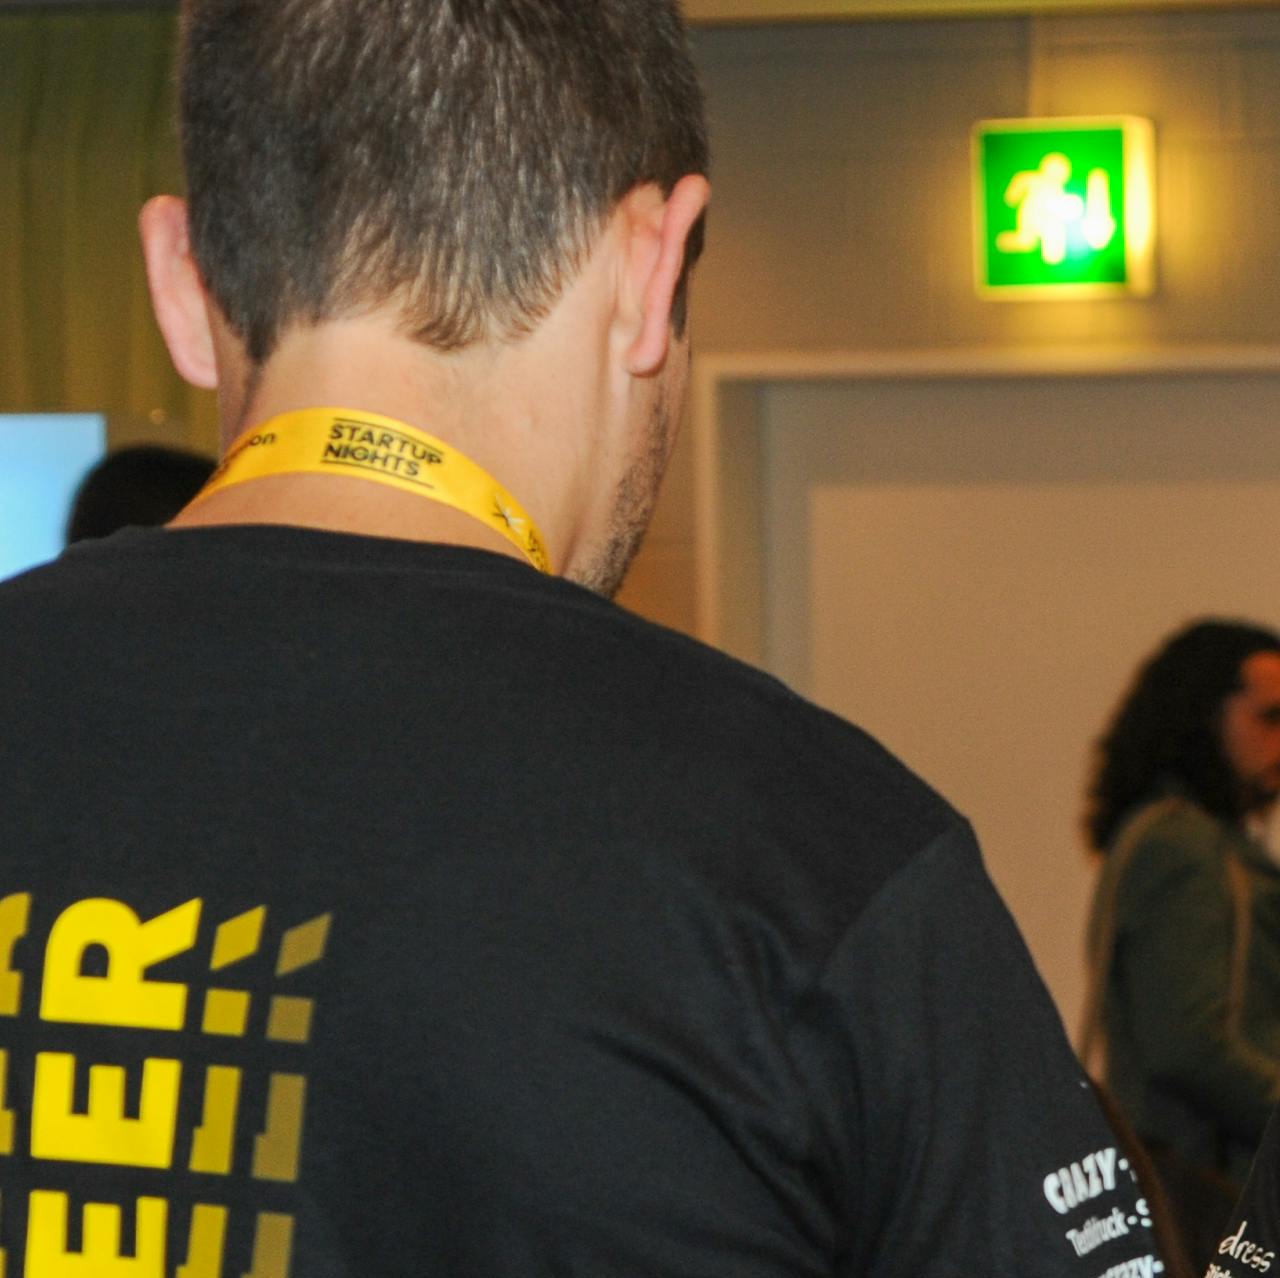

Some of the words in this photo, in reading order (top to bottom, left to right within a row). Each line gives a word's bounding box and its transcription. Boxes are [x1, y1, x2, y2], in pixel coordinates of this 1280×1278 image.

[322, 442, 422, 477] NIGHTS
[328, 423, 445, 467] STARTUP
[1217, 1220, 1276, 1274] dress
